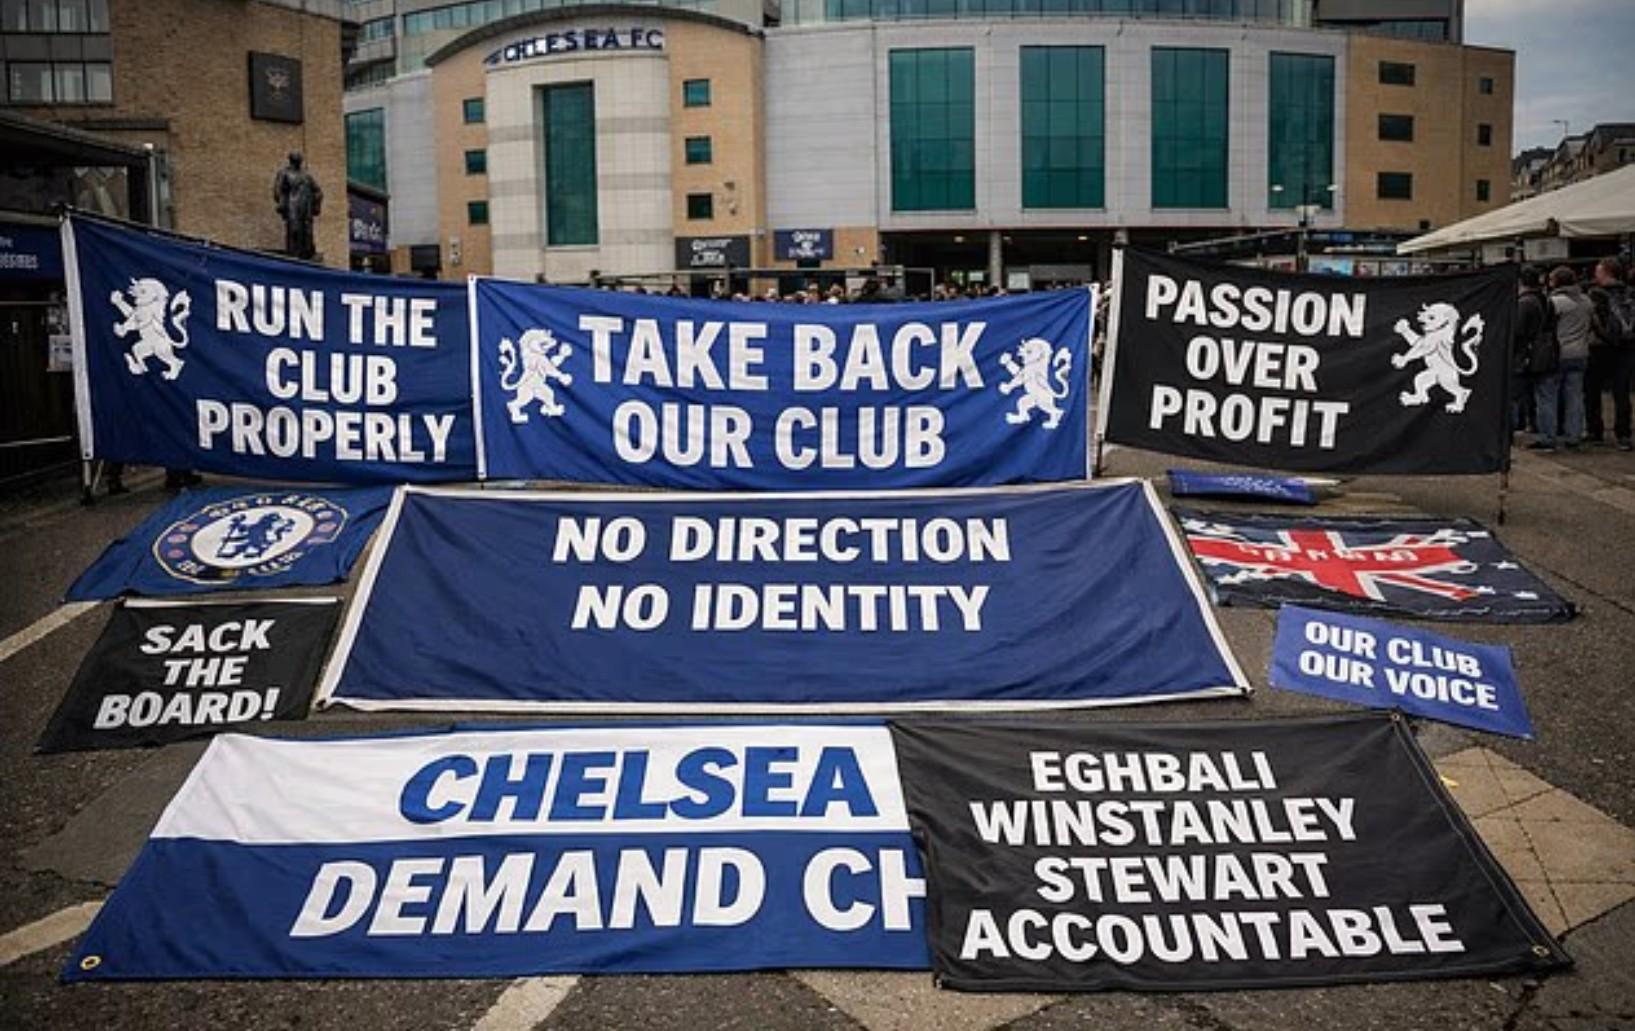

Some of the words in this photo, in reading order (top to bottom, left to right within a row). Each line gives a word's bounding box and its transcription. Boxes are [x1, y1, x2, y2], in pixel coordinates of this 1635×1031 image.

[630, 28, 664, 51] FC
[215, 279, 324, 341] RUN
[341, 293, 437, 347] THE
[1145, 274, 1366, 337] PASSION
[265, 347, 397, 405] CLUB
[578, 314, 769, 391] TAKE
[793, 321, 987, 391] BACK
[1186, 336, 1320, 391] OVER
[196, 399, 456, 463] PROPERLY
[612, 399, 754, 469] OUR
[775, 405, 946, 470] CLUB
[1150, 385, 1349, 448] PROFIT
[552, 516, 646, 562] NO
[669, 516, 1011, 562] DIRECTION
[140, 618, 275, 654] SACK
[571, 584, 669, 631] NO
[692, 583, 990, 632] IDENTITY
[163, 655, 249, 687] THE
[1304, 620, 1377, 660] OUR
[1386, 637, 1482, 678] CLUB
[93, 687, 280, 730] BOARD!
[1299, 650, 1375, 689] OUR
[1383, 667, 1499, 711] VOICE
[399, 746, 879, 825] CHELSEA
[1029, 751, 1277, 793] EGHBALI
[969, 797, 1356, 846] WINSTANLEY
[289, 847, 766, 938] DEMAND
[1034, 852, 1330, 903] STEWART
[960, 904, 1465, 964] ACCOUNTABLE
